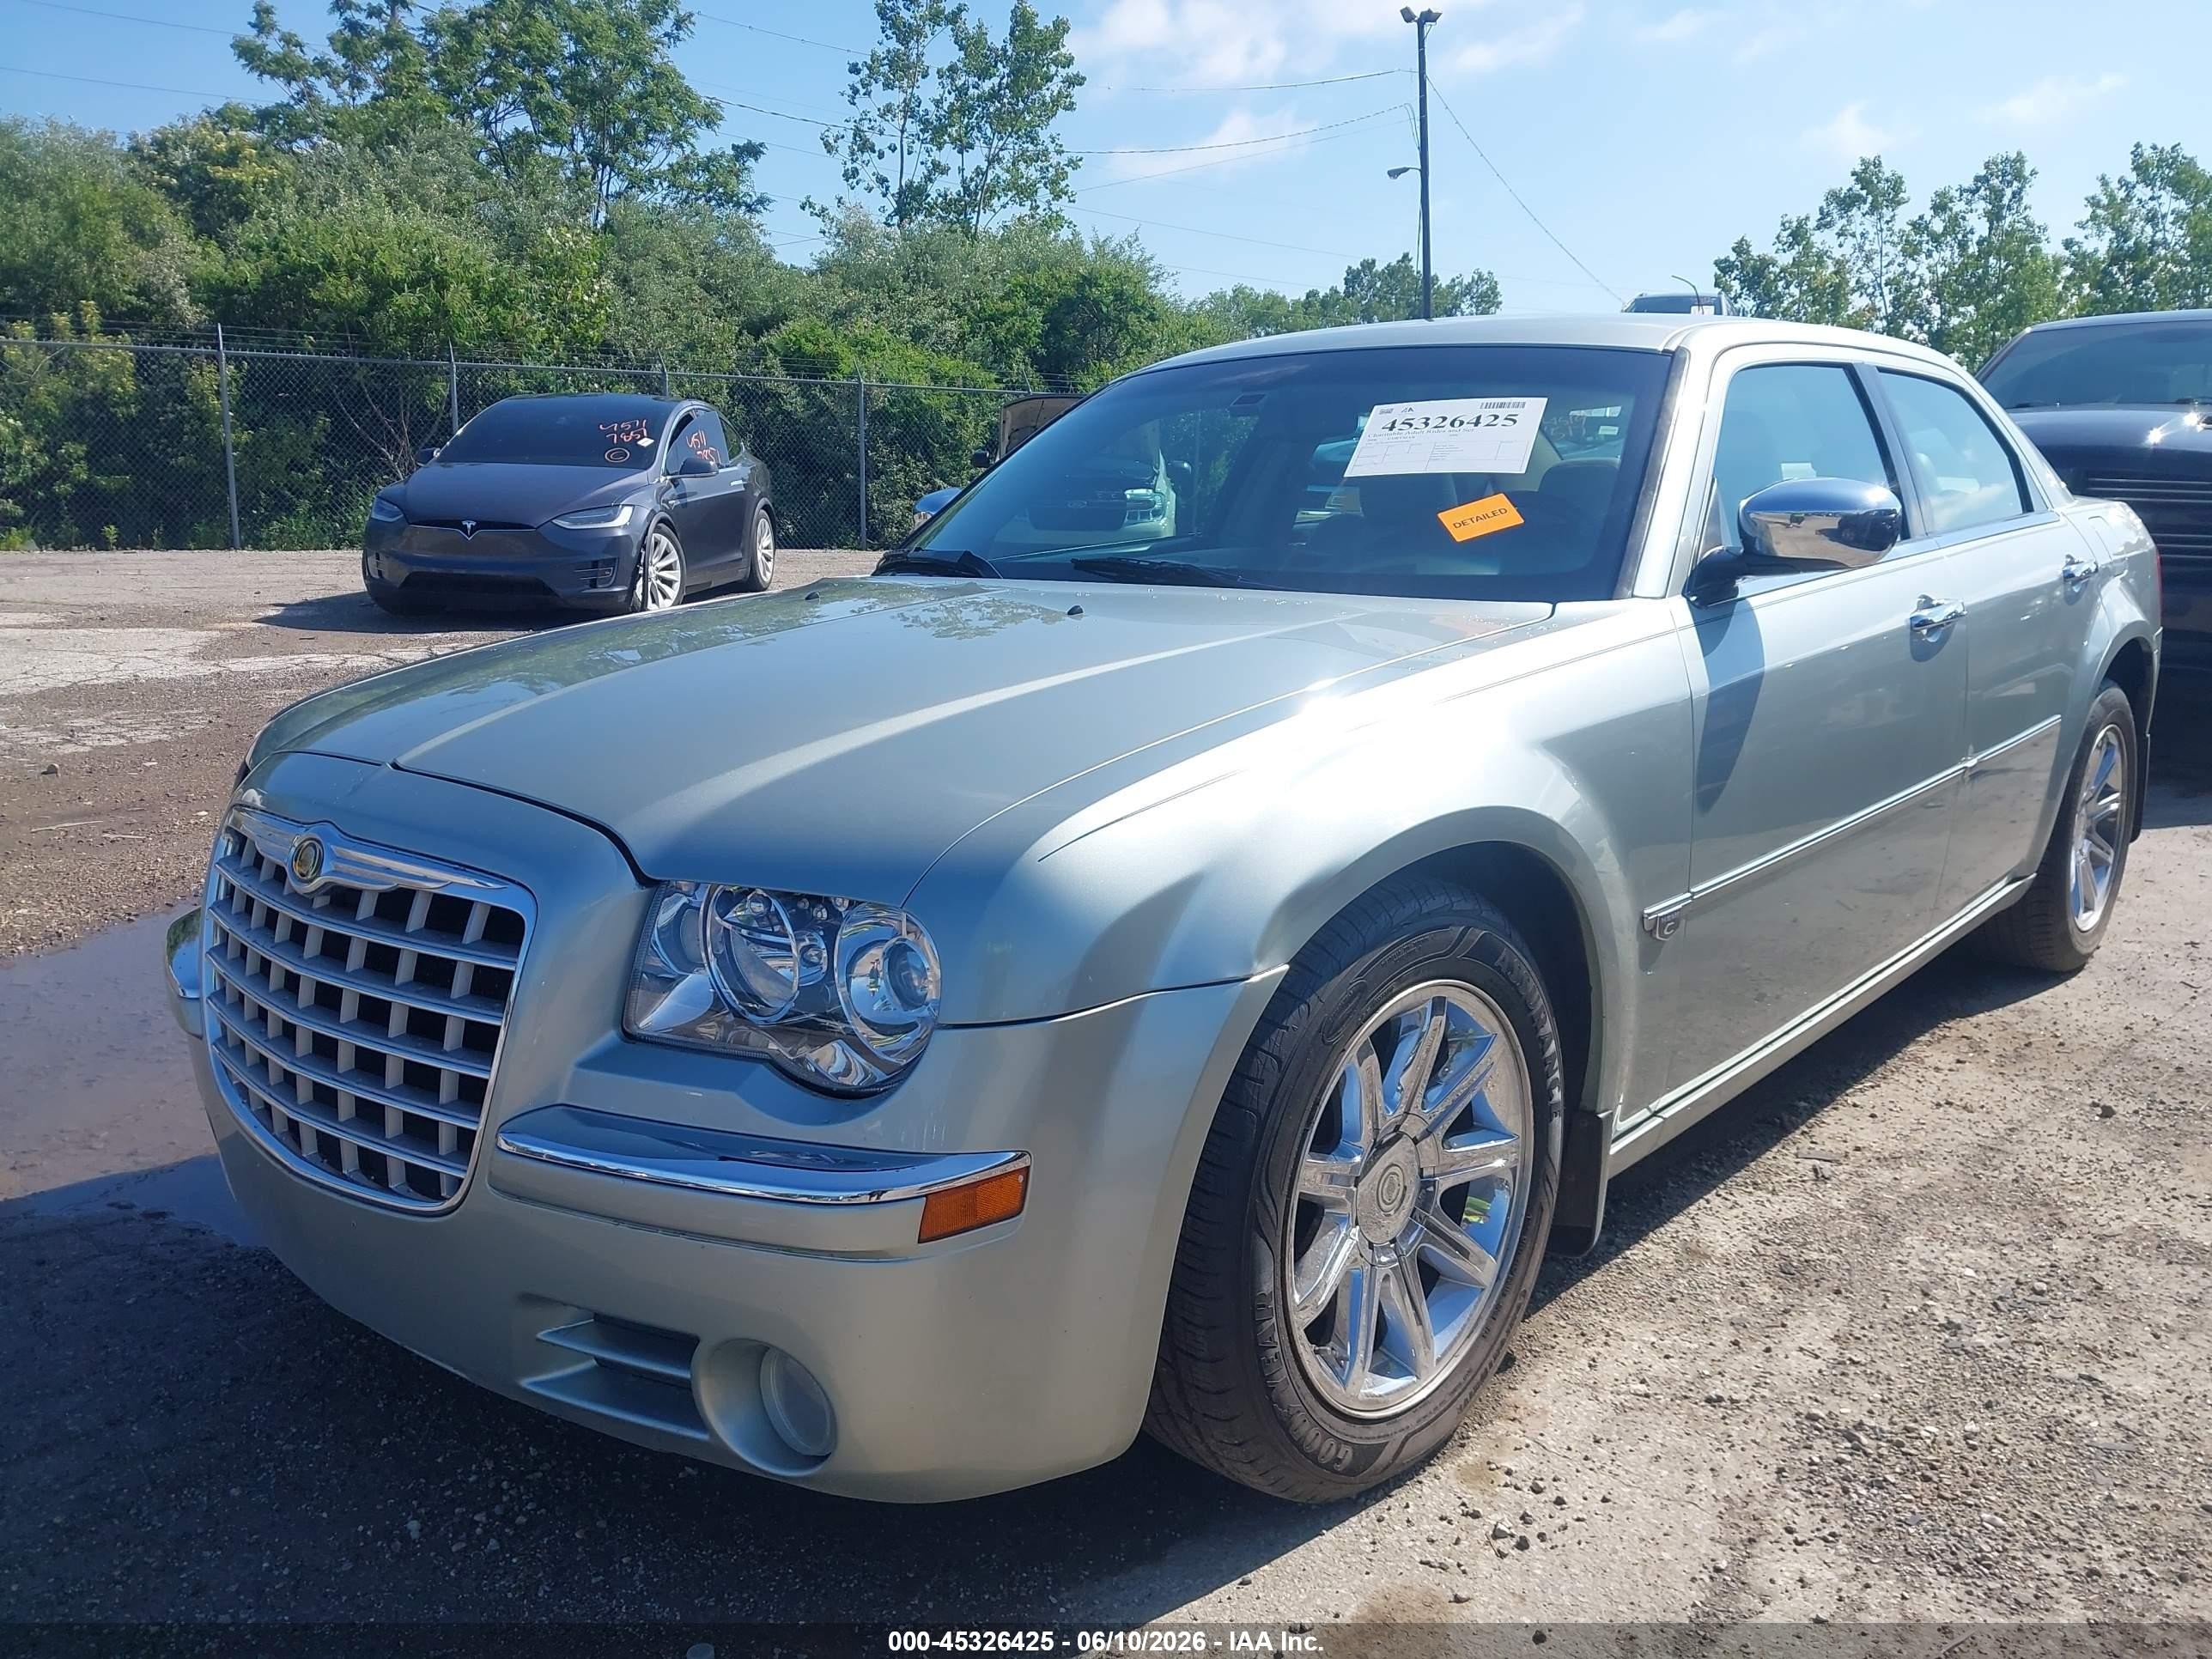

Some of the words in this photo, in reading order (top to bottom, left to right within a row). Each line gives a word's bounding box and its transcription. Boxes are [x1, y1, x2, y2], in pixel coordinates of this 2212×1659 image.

[1381, 413, 1519, 432] 45326425
[1368, 430, 1404, 439] Charitable
[1452, 507, 1508, 529] DETAILED
